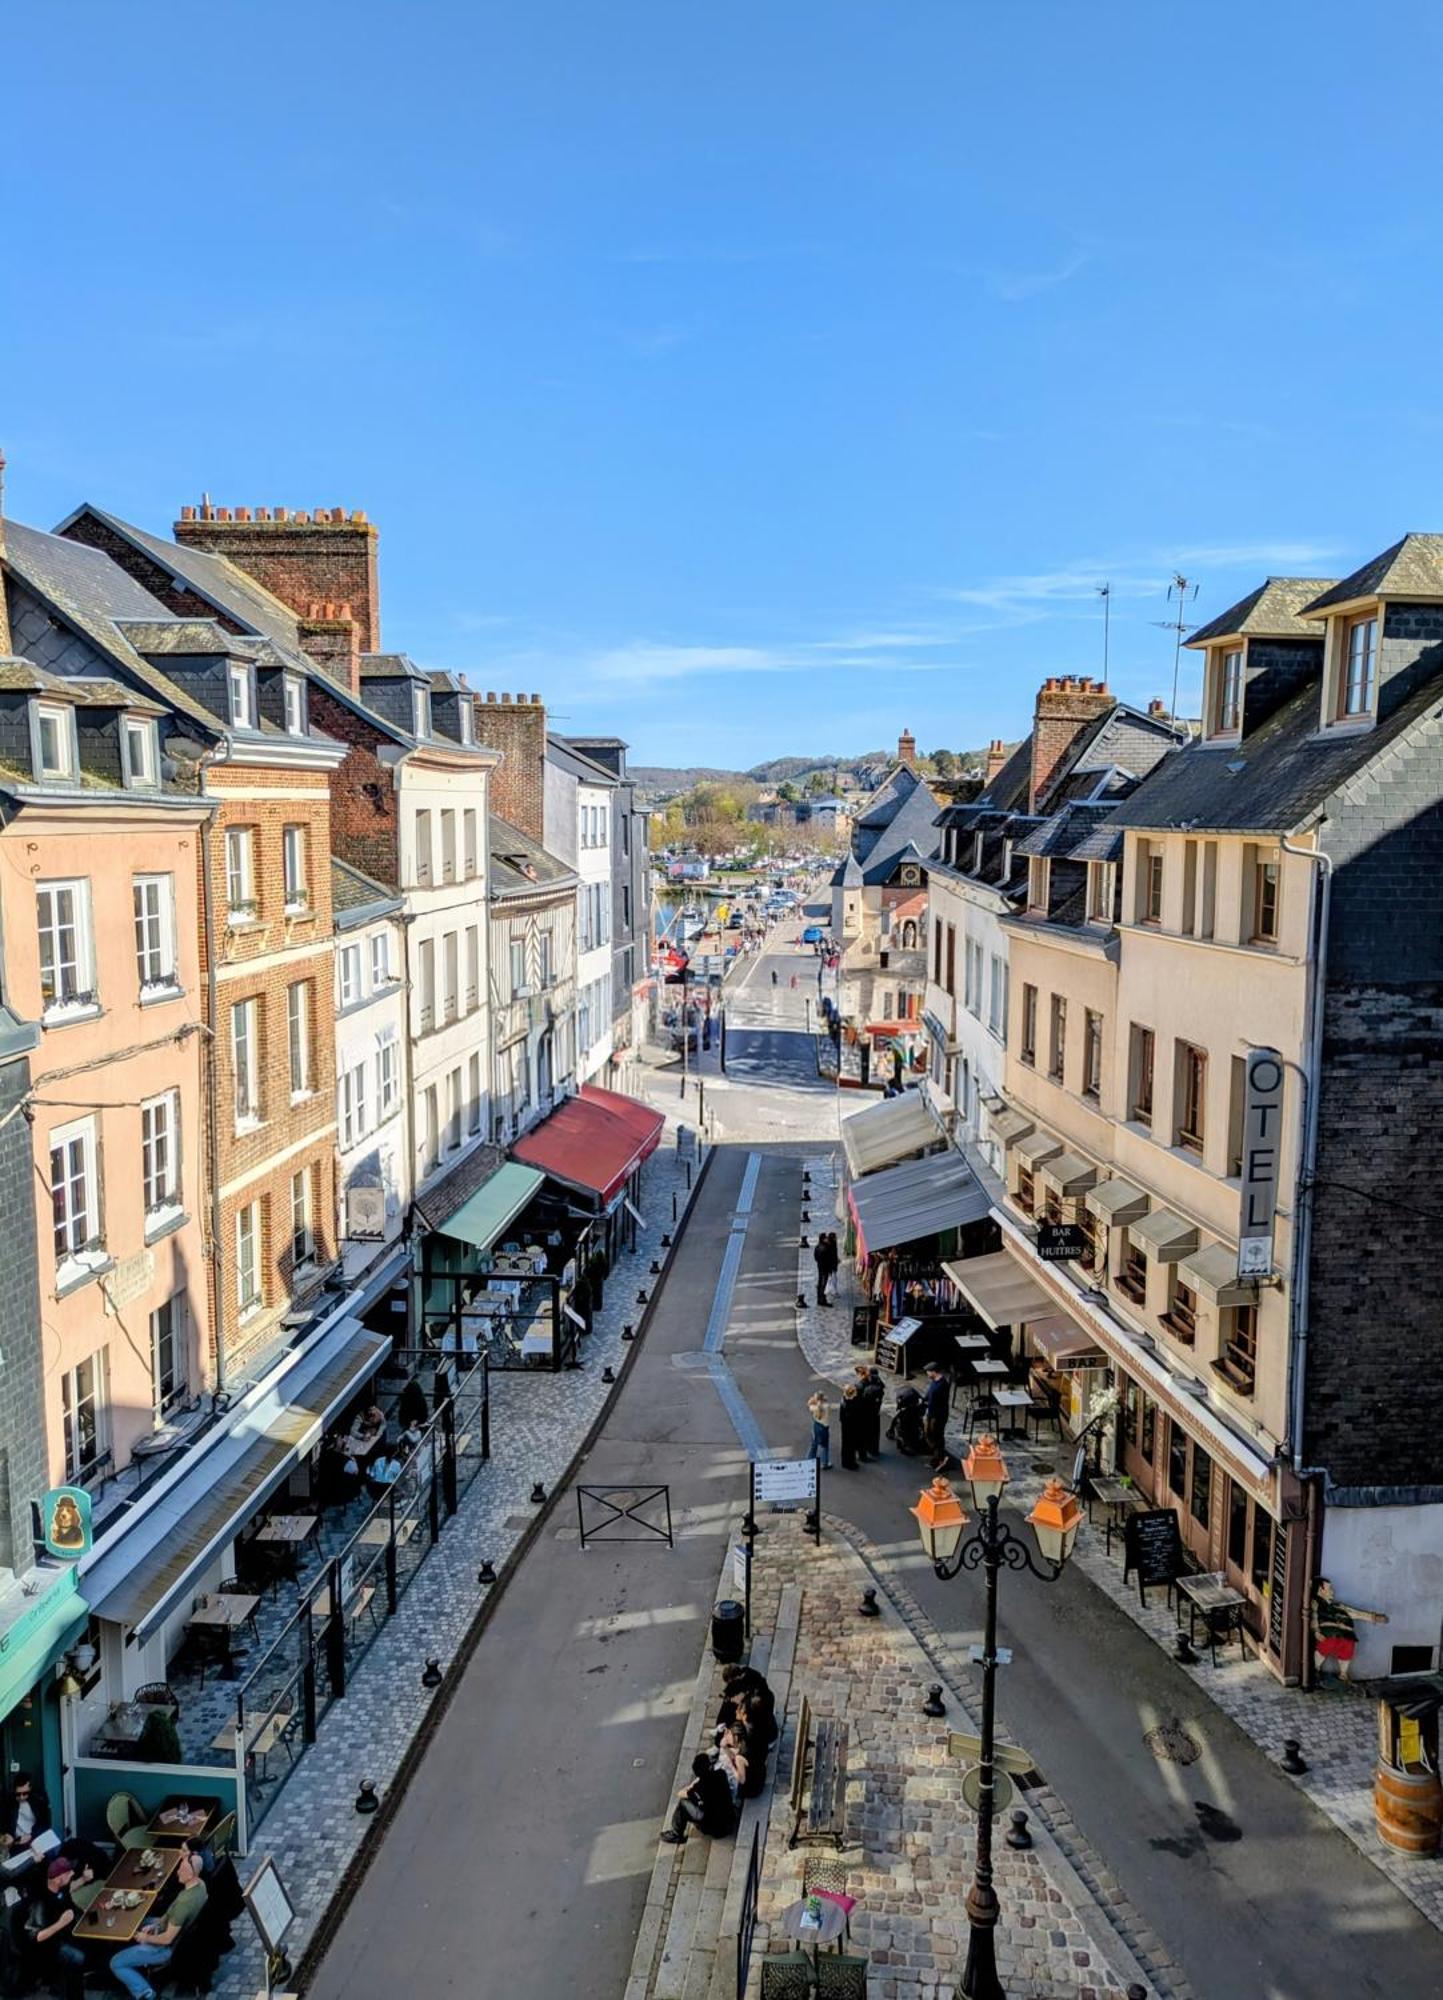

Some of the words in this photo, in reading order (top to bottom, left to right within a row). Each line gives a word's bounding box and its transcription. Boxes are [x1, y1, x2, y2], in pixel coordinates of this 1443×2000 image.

[1248, 1060, 1281, 1227] OTEL
[1051, 1227, 1072, 1237] BAR
[1068, 1357, 1097, 1369] BAR
